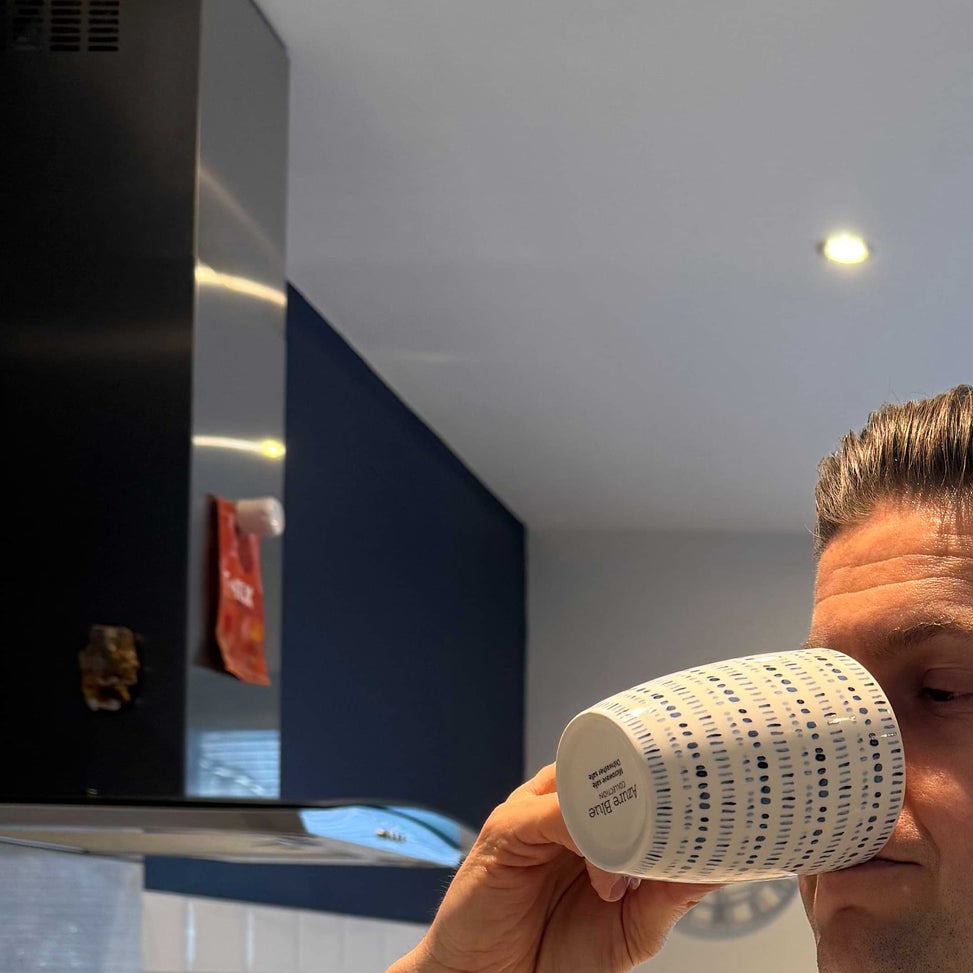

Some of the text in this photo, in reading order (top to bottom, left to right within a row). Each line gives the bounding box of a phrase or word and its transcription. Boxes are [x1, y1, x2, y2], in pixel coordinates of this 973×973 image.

[588, 758, 621, 780] Dishwasher safe
[592, 768, 624, 789] Microwave safe
[599, 781, 625, 799] COLLECTION
[589, 784, 637, 818] Azure Blue
